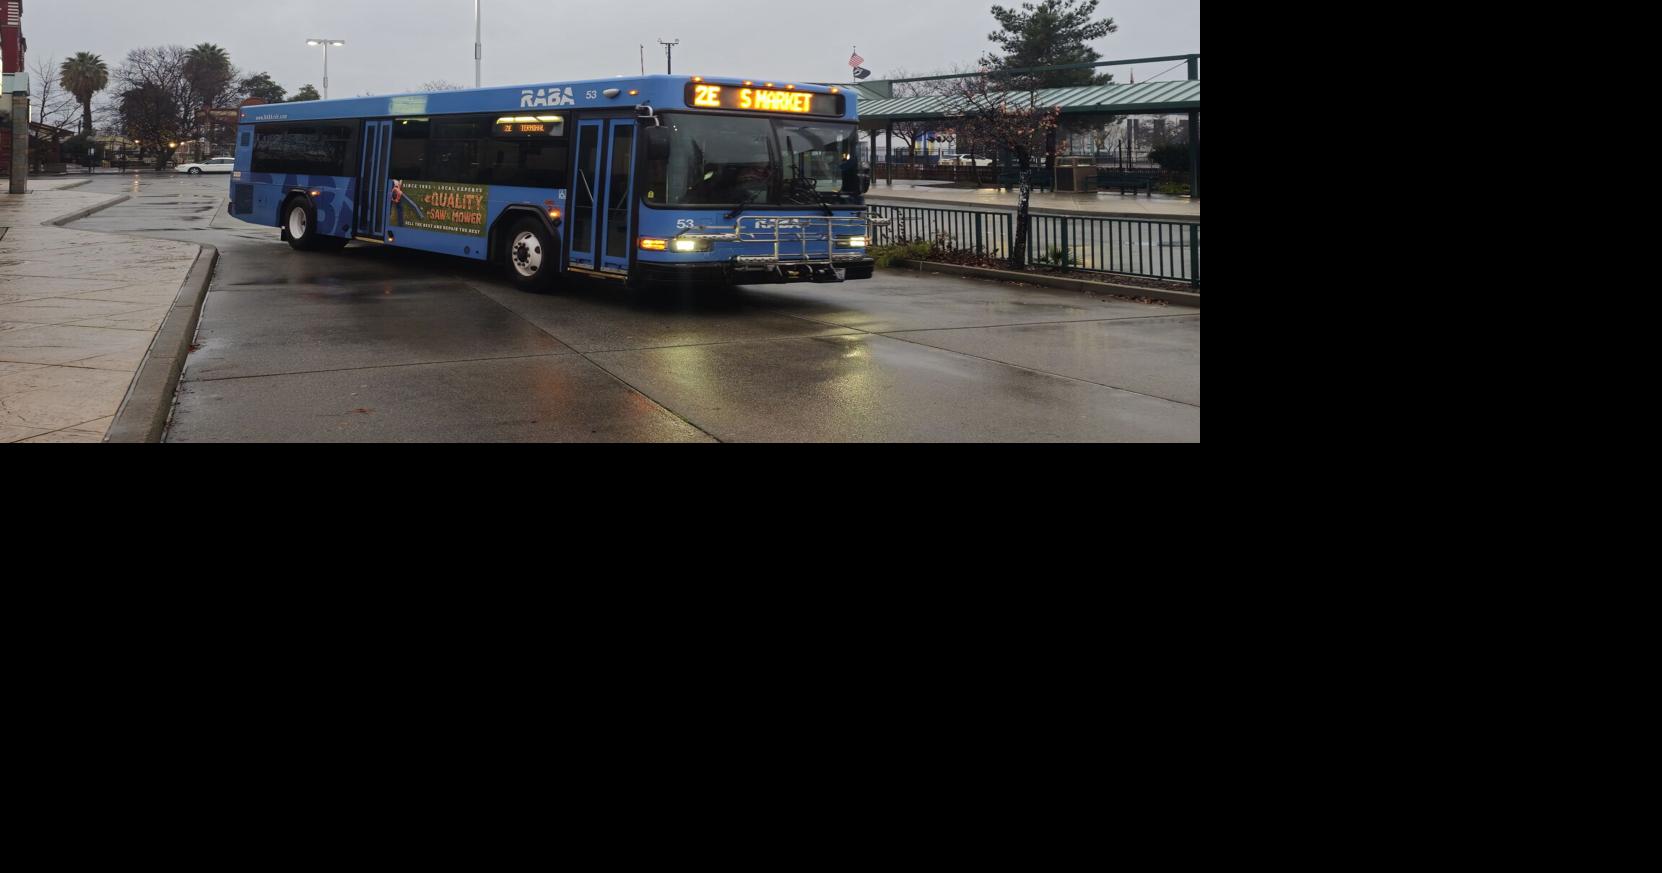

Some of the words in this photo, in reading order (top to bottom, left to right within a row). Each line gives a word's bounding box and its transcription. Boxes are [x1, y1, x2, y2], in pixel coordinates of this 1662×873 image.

[520, 87, 575, 108] RABA
[585, 90, 597, 100] 53
[694, 85, 721, 107] 2E
[739, 88, 752, 109] S
[754, 90, 813, 113] MARKET
[431, 192, 482, 210] QUALITY
[431, 209, 446, 220] SAW
[452, 210, 482, 225] MOWER
[676, 219, 694, 229] 53
